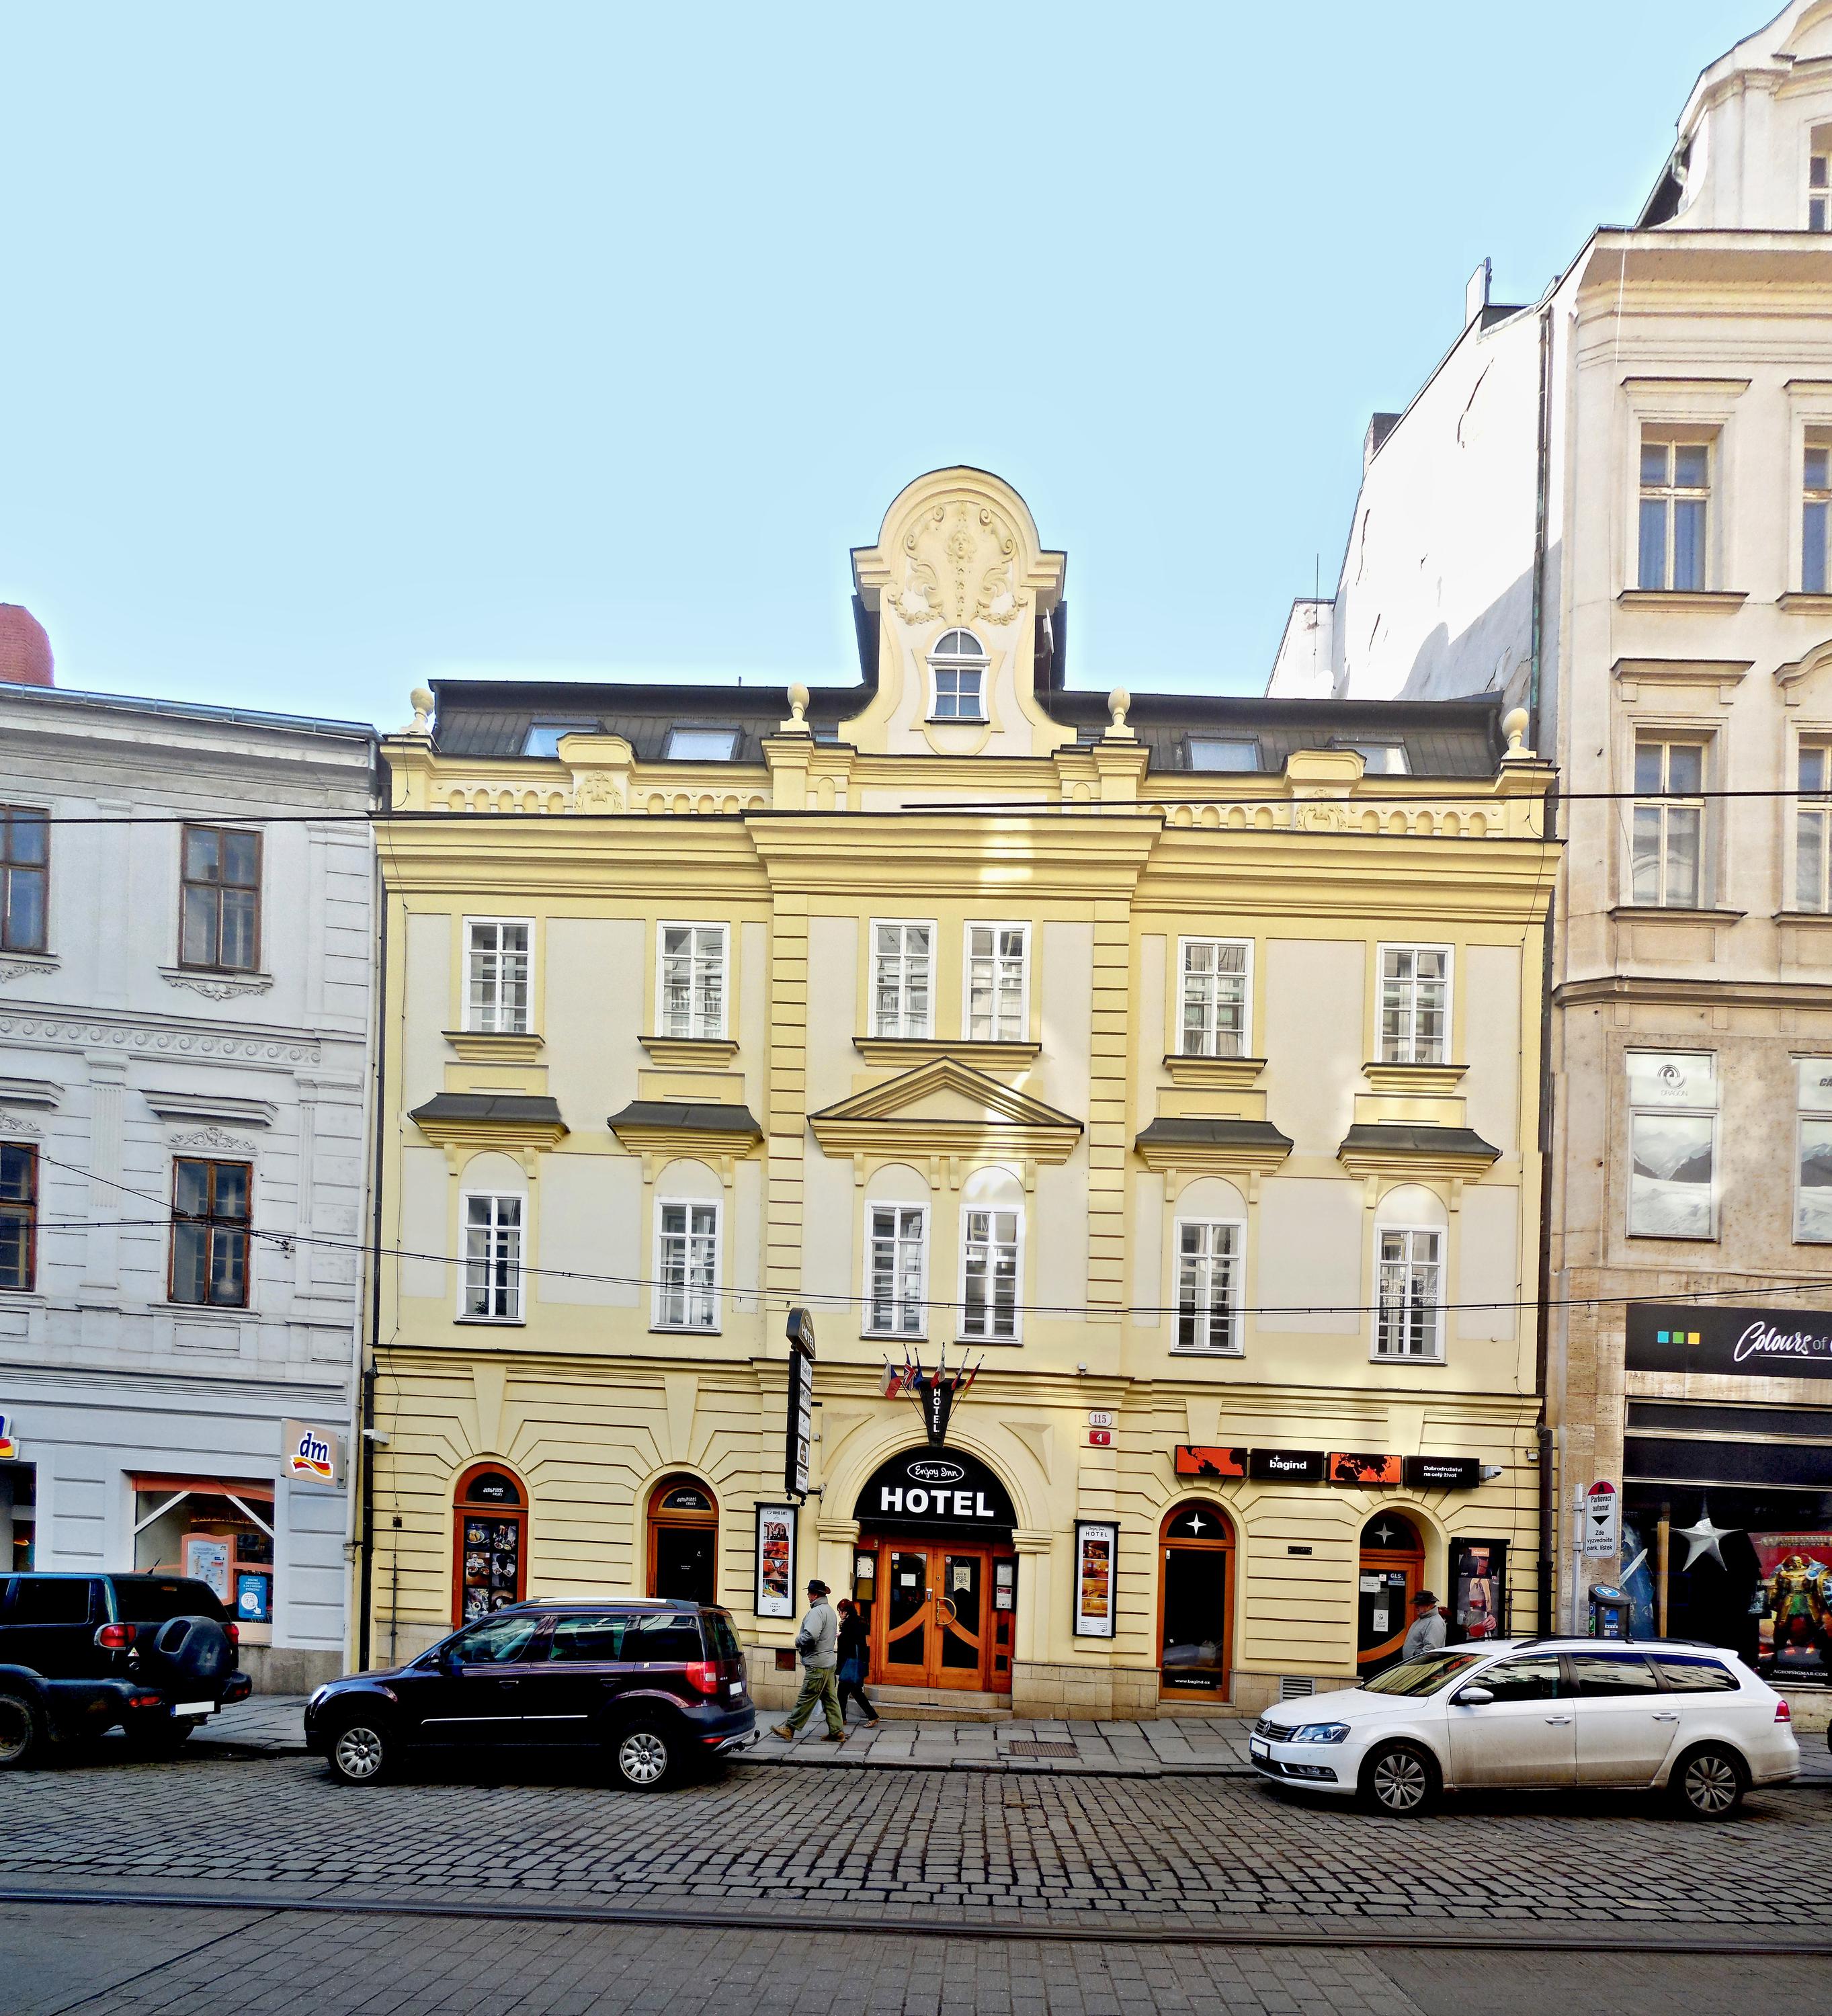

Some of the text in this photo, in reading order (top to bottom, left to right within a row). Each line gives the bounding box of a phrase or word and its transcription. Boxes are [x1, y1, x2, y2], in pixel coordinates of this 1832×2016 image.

[801, 1323, 815, 1351] HOTEL
[1733, 1321, 1813, 1361] Colours
[1813, 1337, 1828, 1350] of
[933, 1388, 941, 1433] HOTEL
[1093, 1414, 1107, 1423] 115
[300, 1432, 328, 1462] dm
[1096, 1433, 1103, 1442] 4
[915, 1465, 959, 1478] Enjoy Inn
[1269, 1460, 1307, 1470] bagind
[1598, 1483, 1605, 1493] A
[881, 1486, 994, 1517] HOTEL
